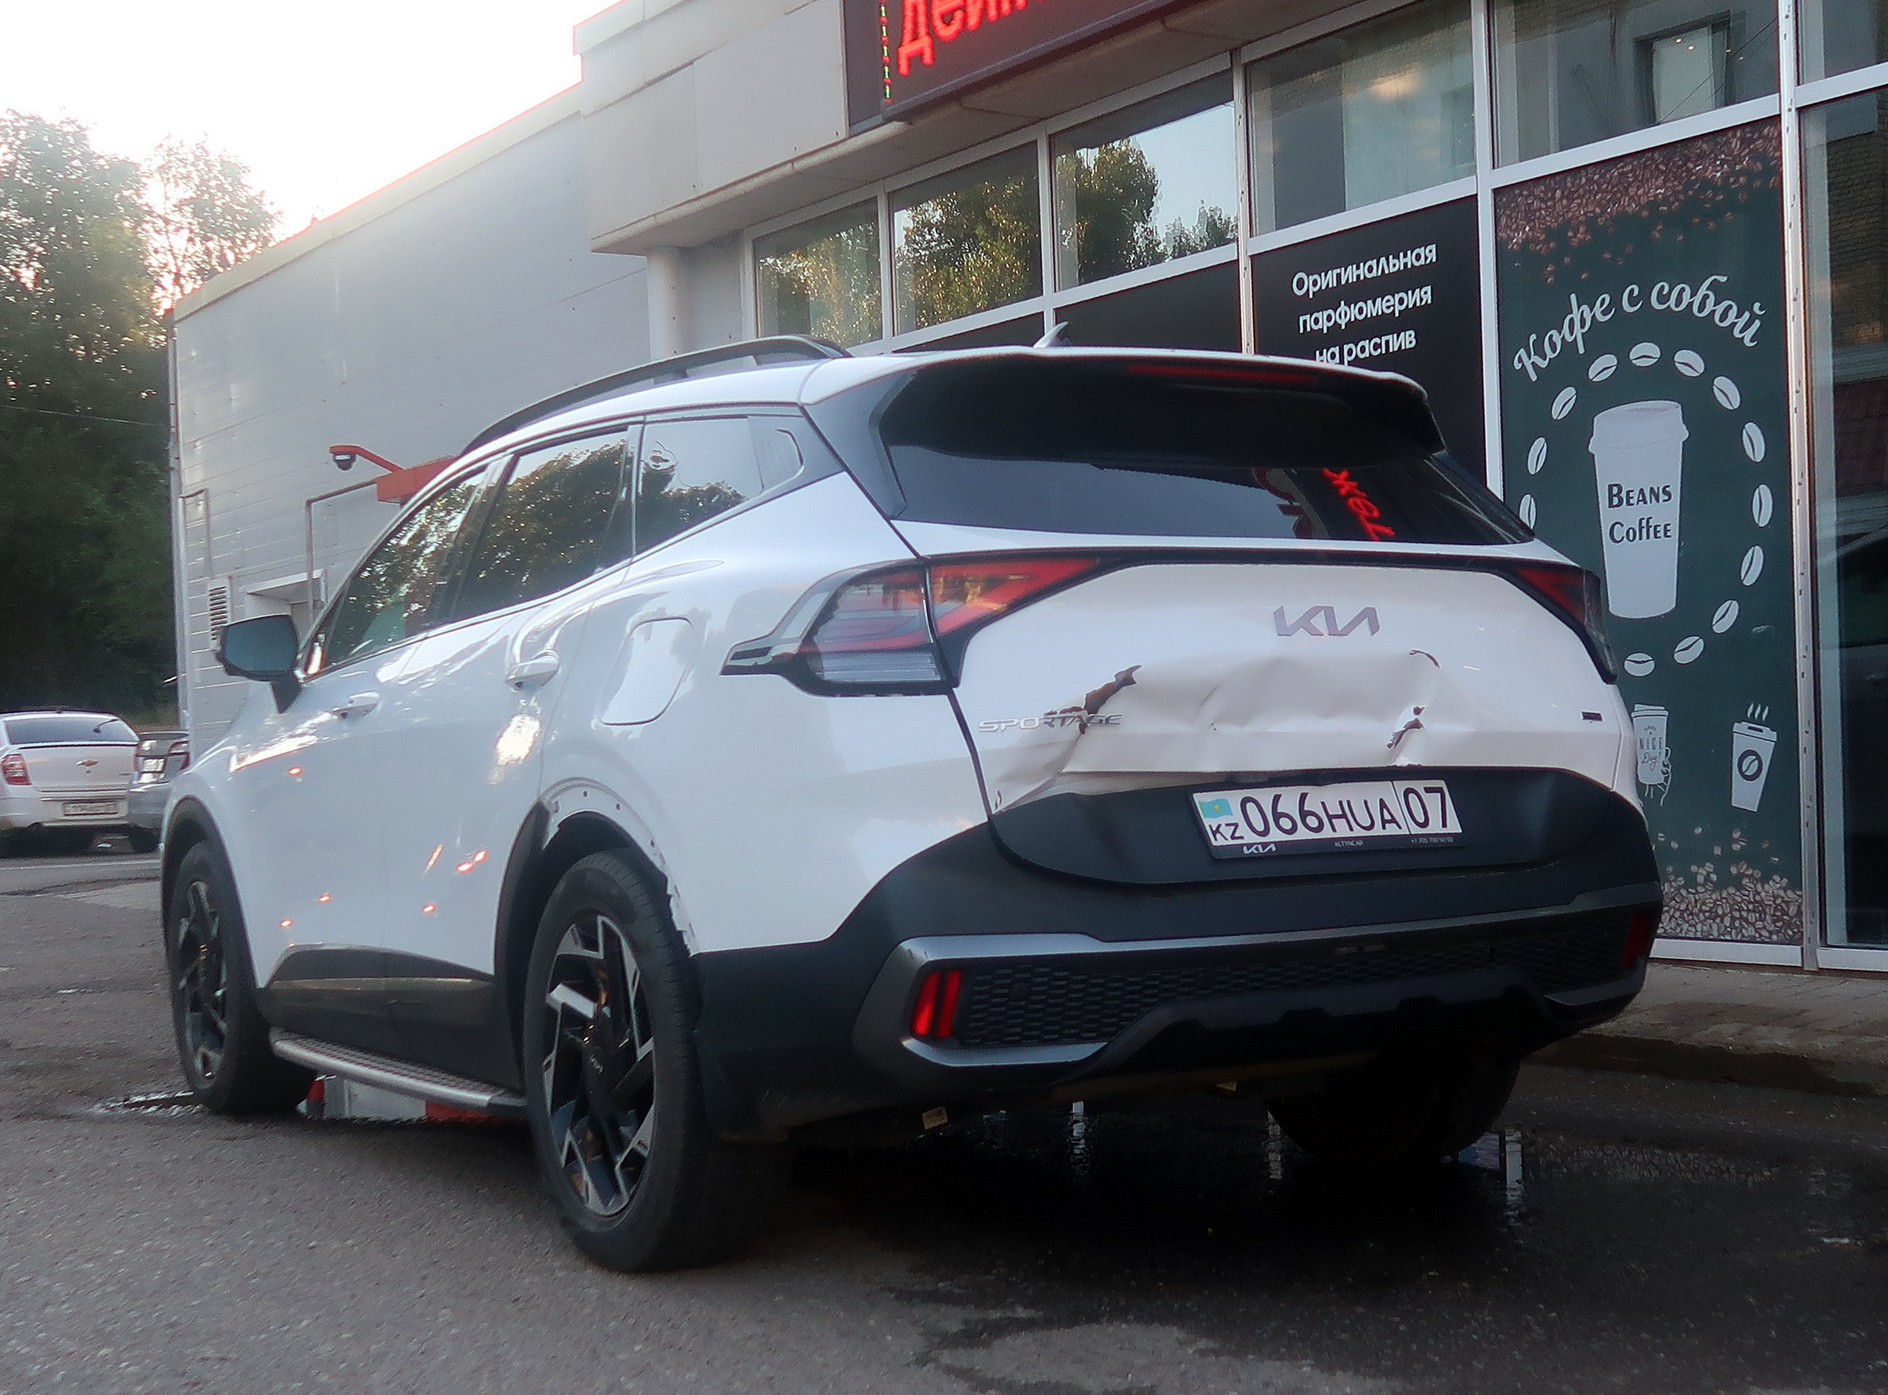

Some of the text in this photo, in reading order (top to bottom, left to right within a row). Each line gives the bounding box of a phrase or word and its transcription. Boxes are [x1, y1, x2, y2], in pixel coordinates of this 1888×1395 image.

[1292, 243, 1437, 299] Оригинальная
[1298, 285, 1433, 334] парфюмерия
[1513, 275, 1767, 382] Кофе с собой
[1315, 330, 1417, 366] на распив
[1607, 483, 1672, 509] BEANS
[1273, 605, 1380, 636] KIA
[978, 713, 1123, 733] SPORTAGE
[1402, 786, 1449, 829] 07
[1208, 822, 1245, 842] KZ
[1243, 843, 1276, 855] KIA
